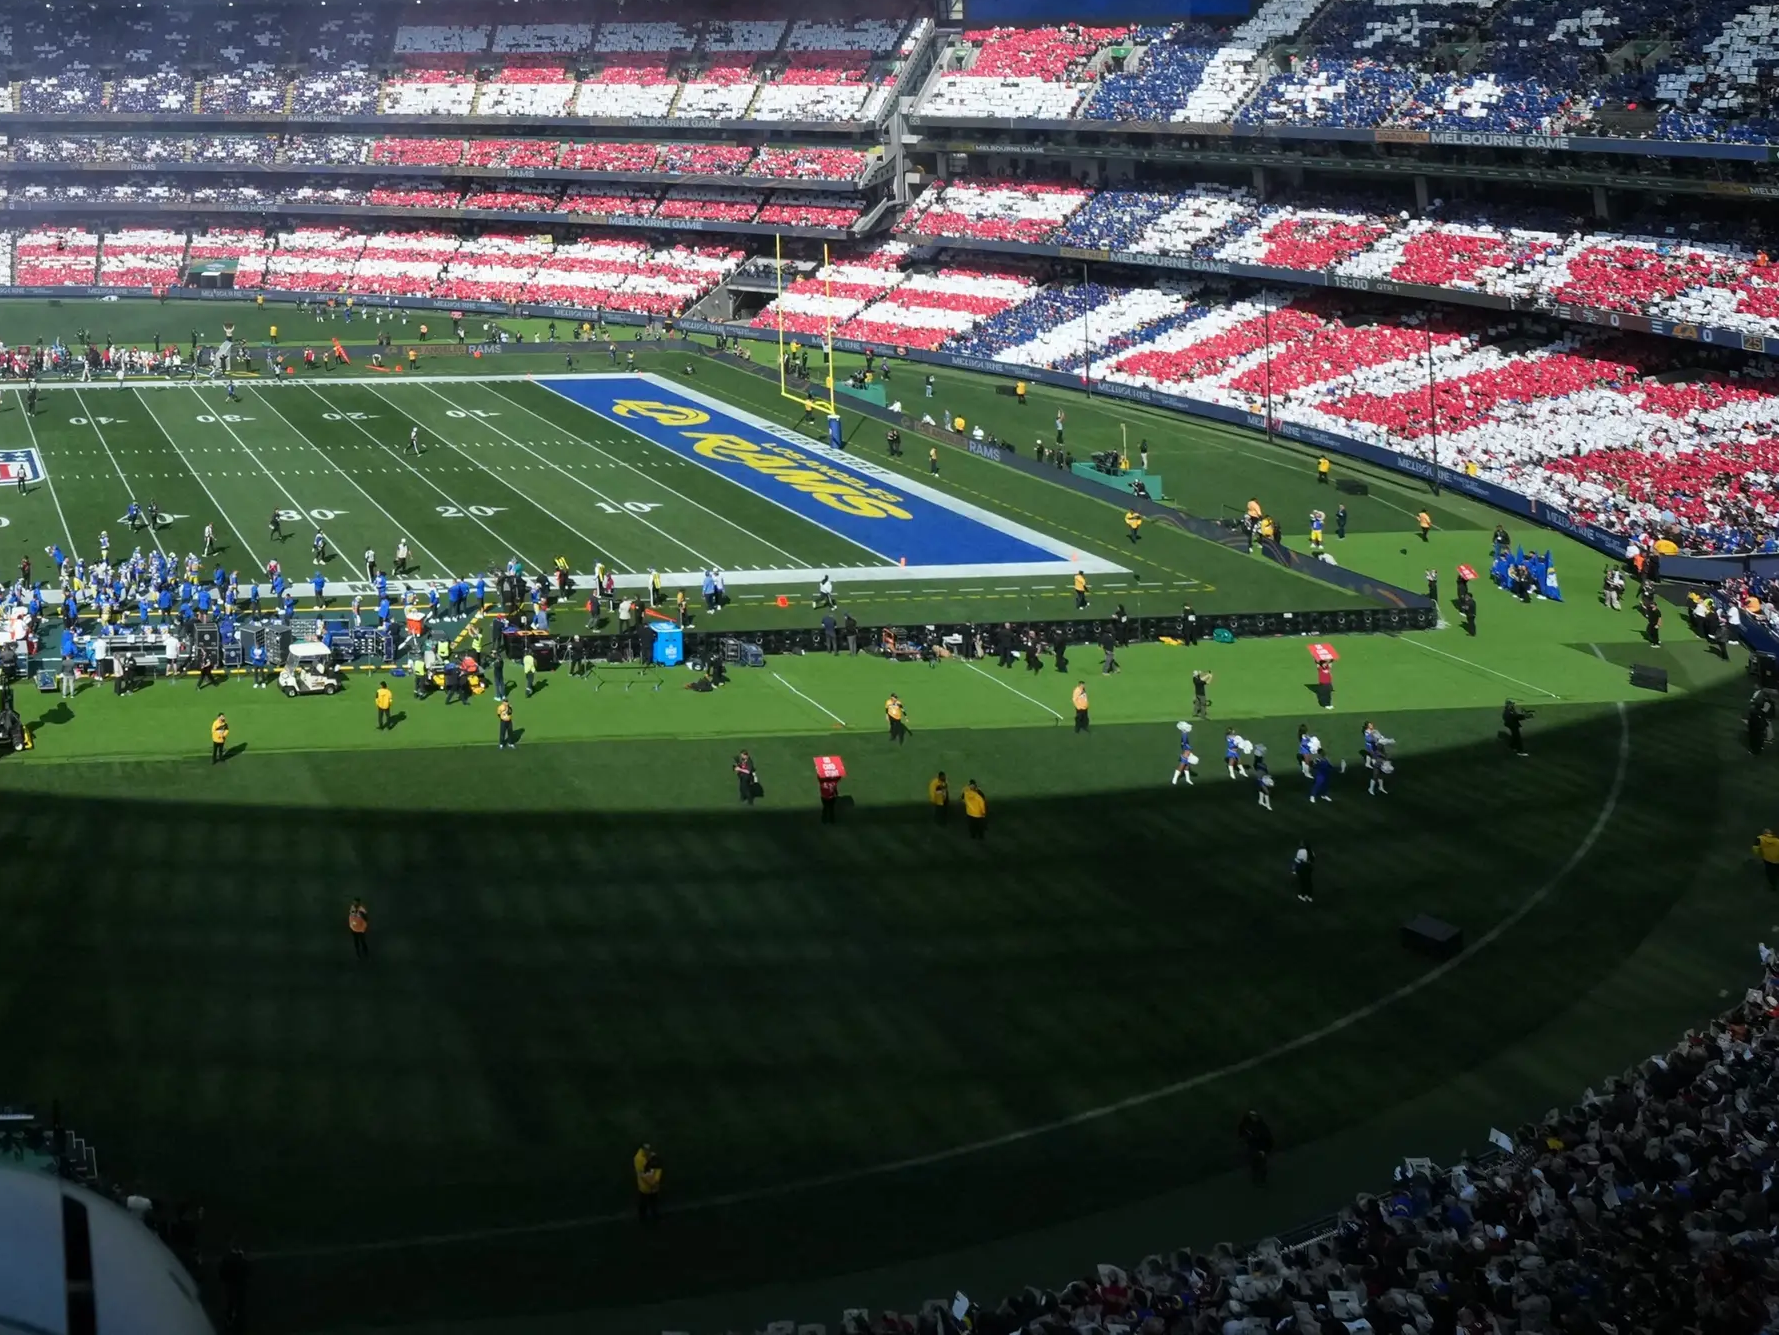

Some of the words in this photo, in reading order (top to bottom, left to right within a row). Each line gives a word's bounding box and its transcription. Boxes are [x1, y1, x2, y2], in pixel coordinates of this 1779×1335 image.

[629, 118, 685, 127] MELBOURNE
[686, 120, 721, 128] GAME
[1431, 132, 1522, 147] MELBOURNE
[1525, 136, 1569, 149] GAME
[976, 145, 1020, 153] MELBOURNE
[131, 163, 156, 171] RAMS
[507, 169, 534, 178] RAMS
[250, 204, 278, 212] HOUSE
[608, 216, 670, 227] MELBOURNE
[672, 220, 702, 230] GAME
[1110, 251, 1190, 269] MELBOURNE
[1192, 260, 1229, 273] GAME
[1334, 276, 1369, 290] 15:00
[1376, 283, 1393, 292] QTR
[1611, 315, 1619, 327] 0
[1703, 330, 1712, 342] 0
[1744, 337, 1763, 350] 25
[468, 345, 502, 354] RAMS
[951, 356, 1003, 372] MELBOURNE
[1098, 383, 1151, 401] MELBOURNE
[969, 440, 1001, 461] RAMS
[679, 431, 913, 520] RAMS
[761, 442, 806, 462] LOS
[803, 460, 903, 502] ANGELES
[436, 505, 495, 517] 20
[594, 501, 652, 514] 10
